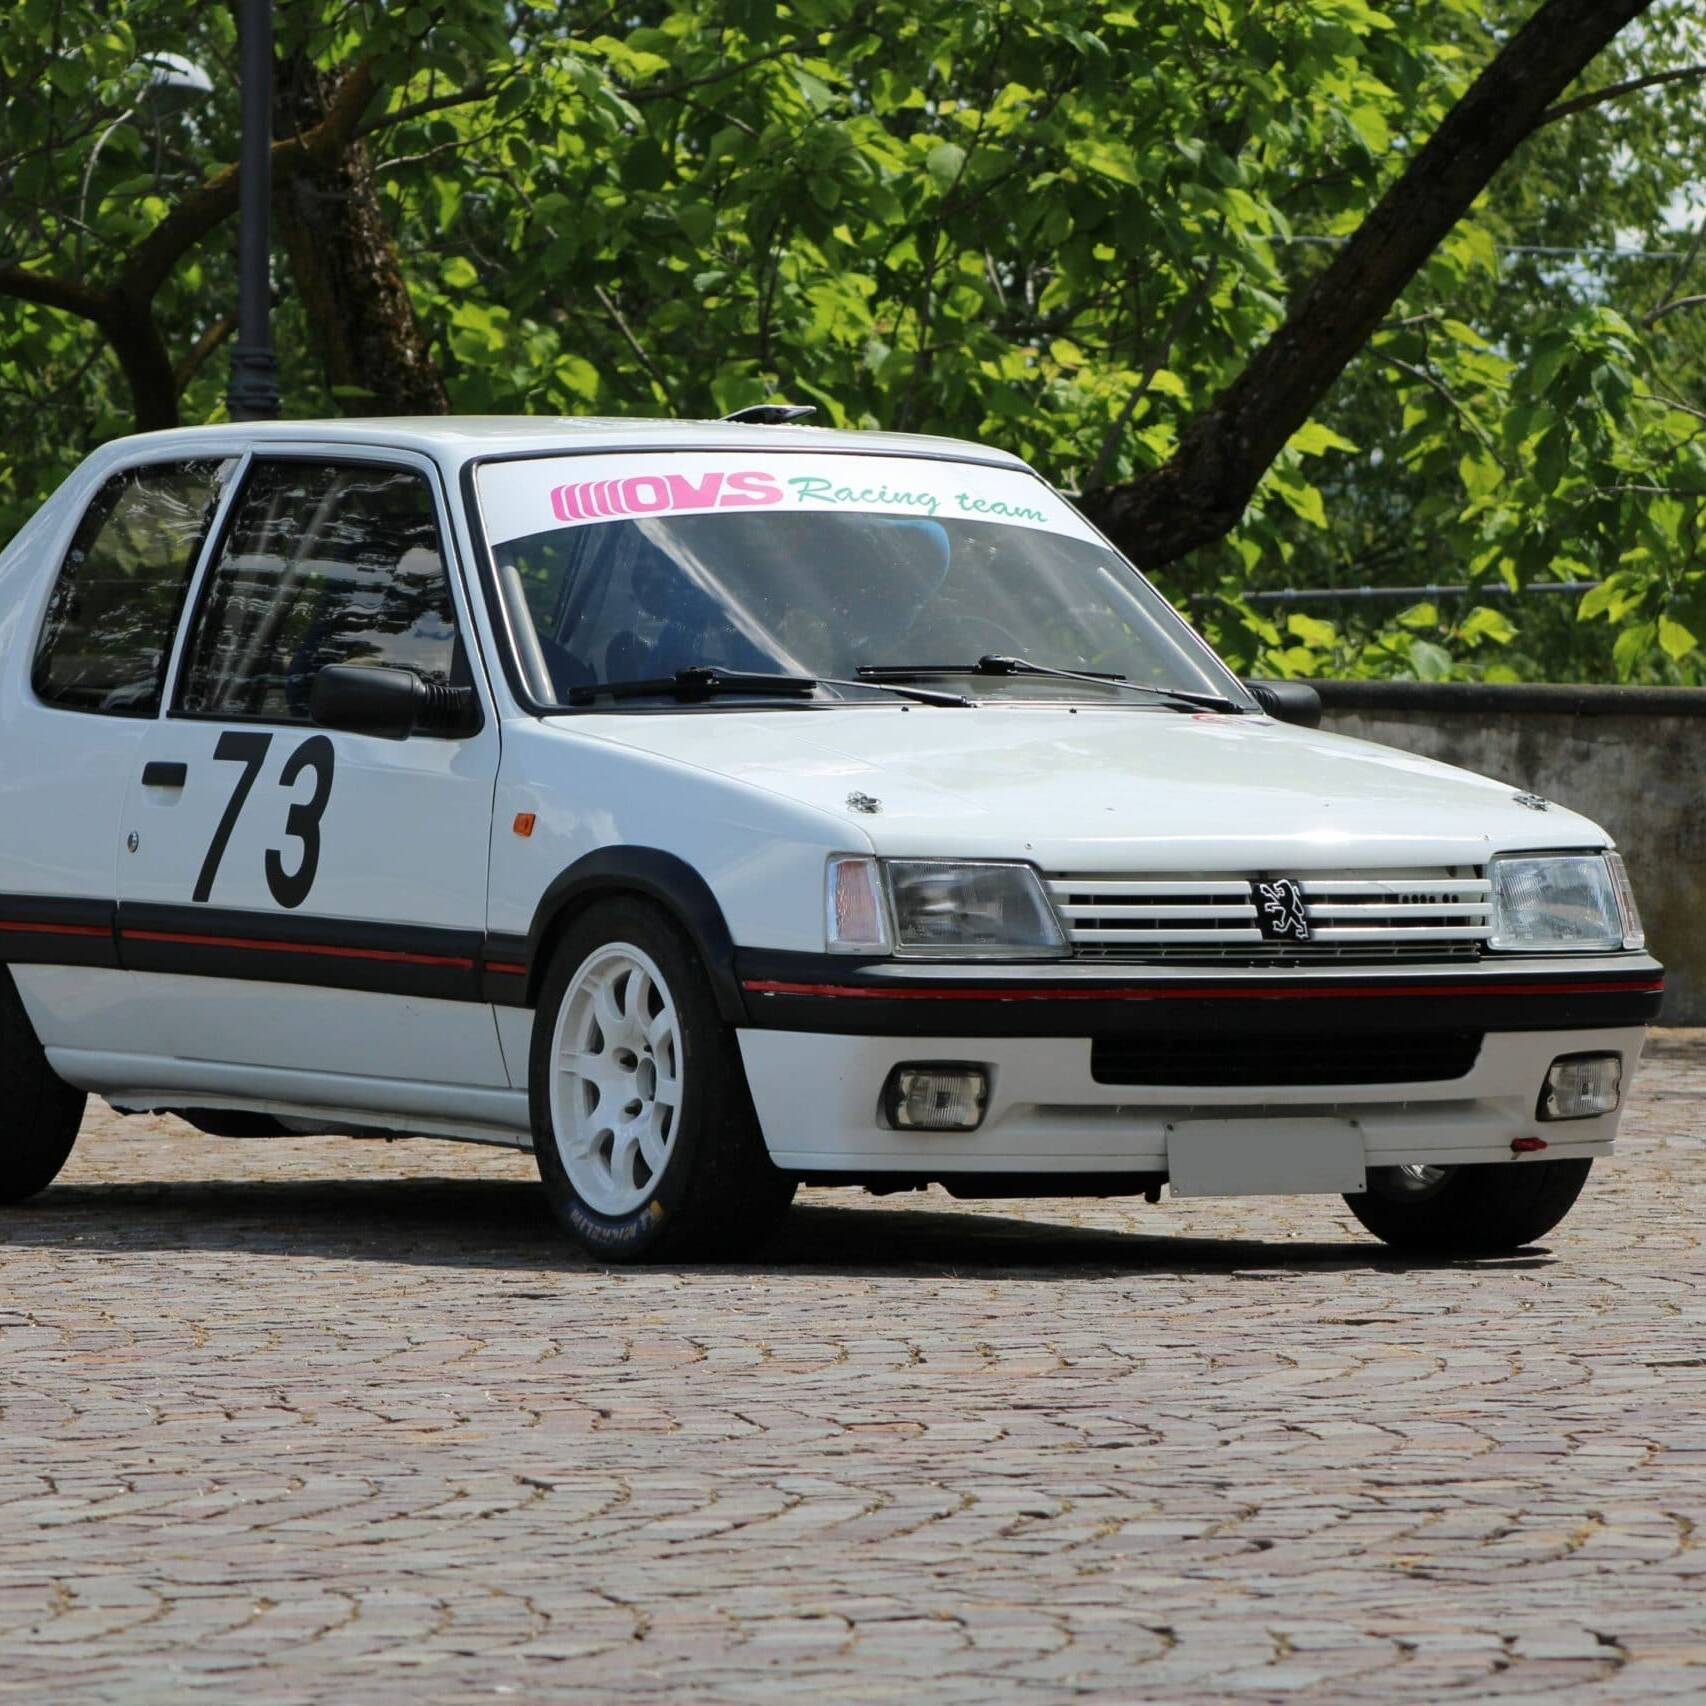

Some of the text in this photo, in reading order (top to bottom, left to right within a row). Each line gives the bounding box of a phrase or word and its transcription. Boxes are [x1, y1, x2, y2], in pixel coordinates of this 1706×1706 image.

[625, 471, 1049, 524] OVS Racing team
[192, 731, 334, 908] 73
